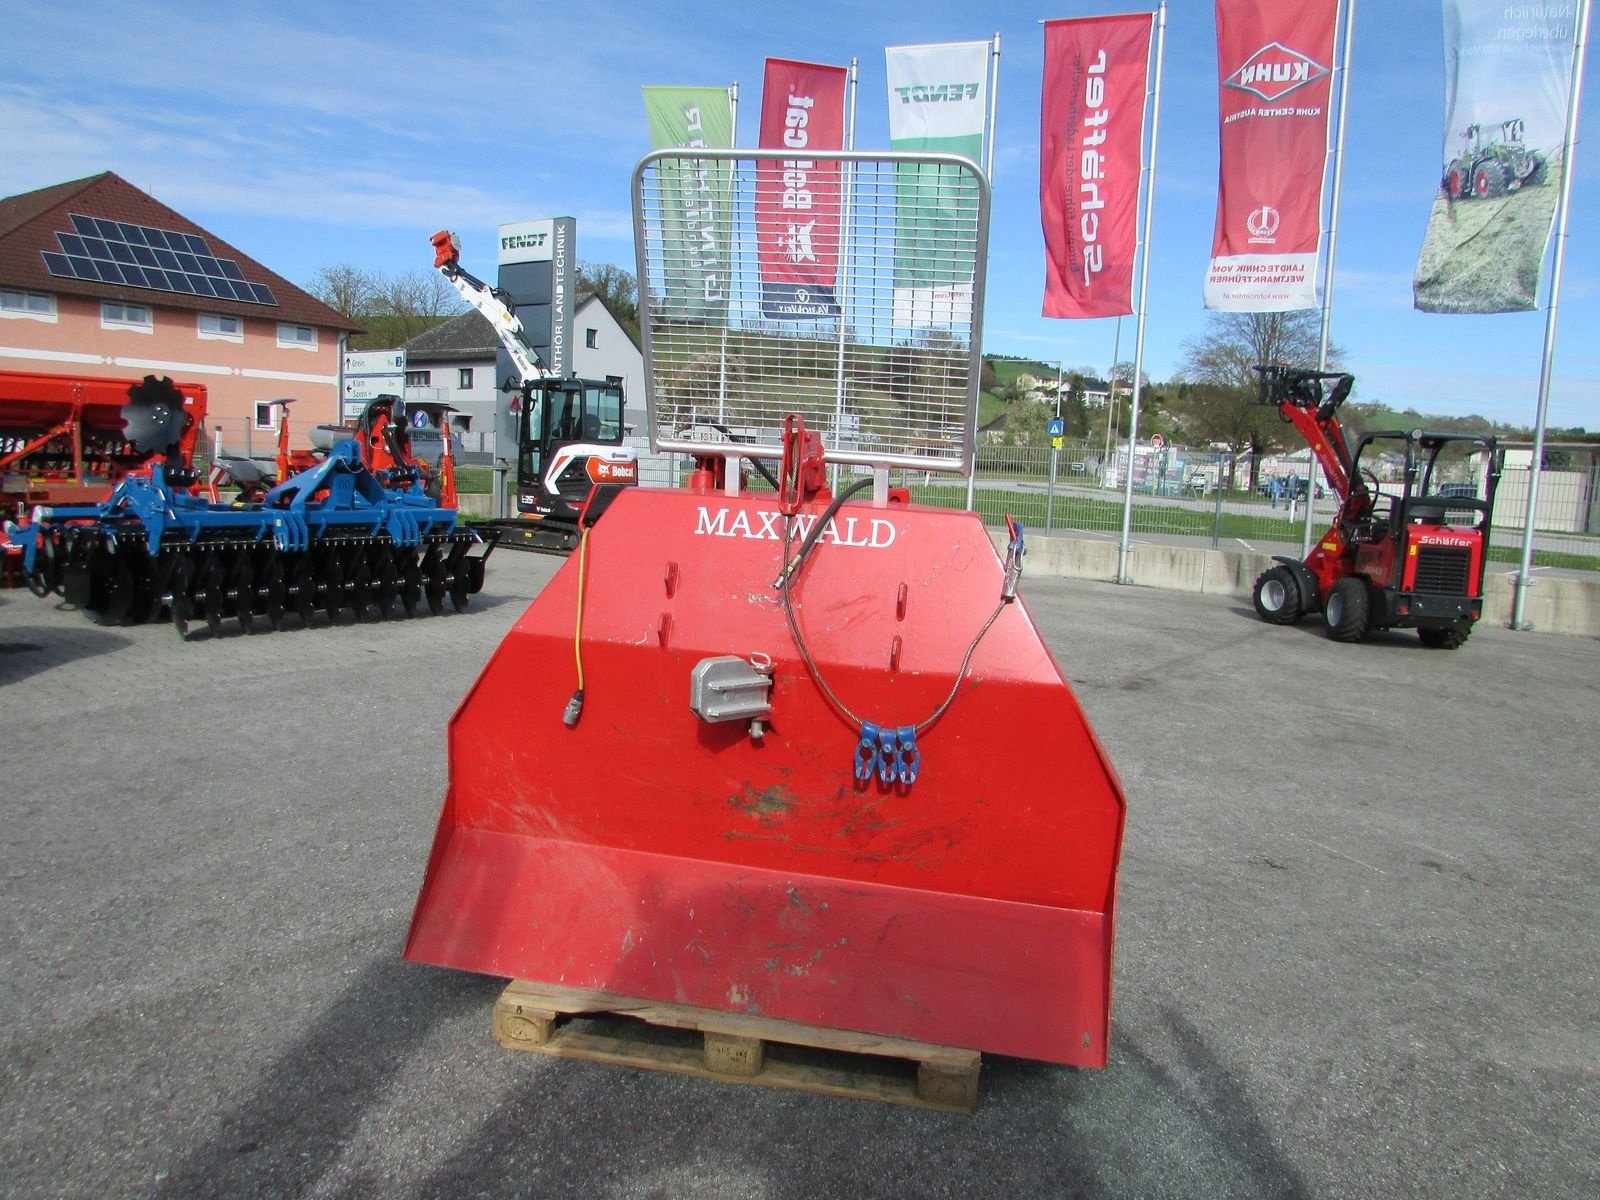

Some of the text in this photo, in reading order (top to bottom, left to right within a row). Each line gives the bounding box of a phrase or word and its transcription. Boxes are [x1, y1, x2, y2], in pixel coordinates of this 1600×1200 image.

[501, 233, 548, 250] FENDT
[554, 224, 567, 377] INTHÖR LANDTECHNIK
[612, 466, 634, 478] Bobcat
[694, 506, 897, 548] MAXWALD
[1418, 535, 1472, 547] Schäffer
